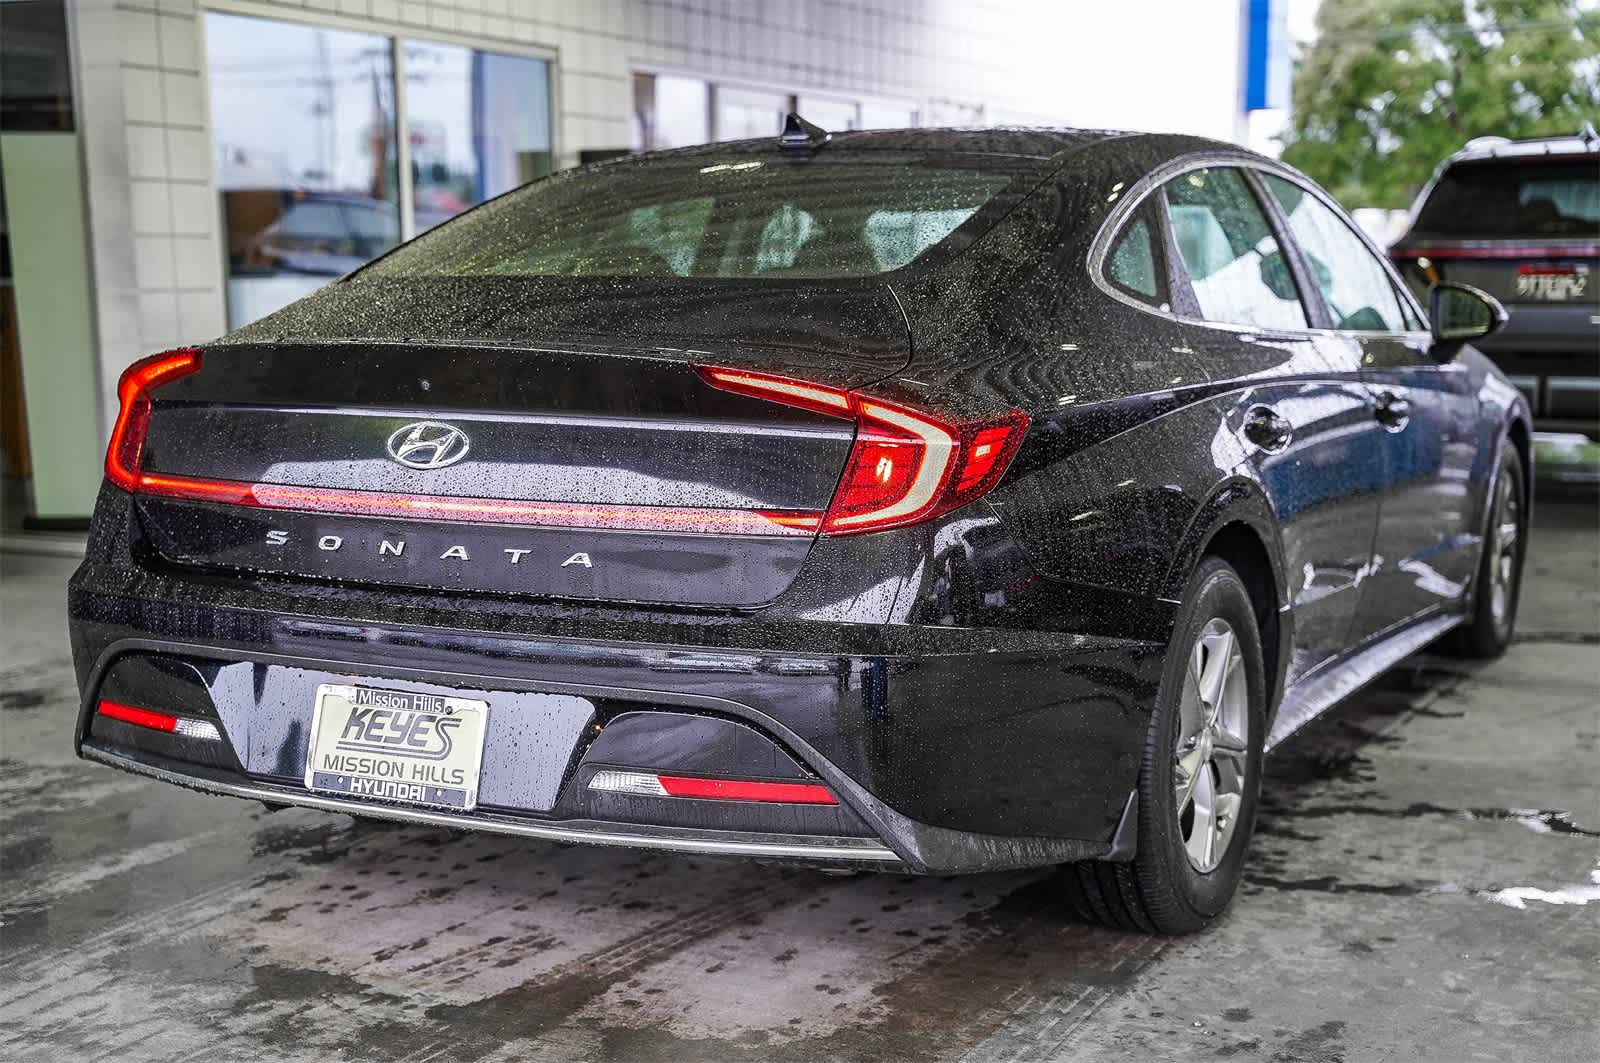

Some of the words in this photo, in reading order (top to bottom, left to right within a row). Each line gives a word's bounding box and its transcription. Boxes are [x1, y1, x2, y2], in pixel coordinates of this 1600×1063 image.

[265, 530, 593, 568] SONATA
[358, 690, 408, 709] Mission
[413, 696, 443, 713] Hills
[340, 707, 463, 758] KEYES
[323, 754, 404, 778] MISSION
[412, 764, 465, 785] HILLS
[350, 777, 427, 801] HYUNDAI
